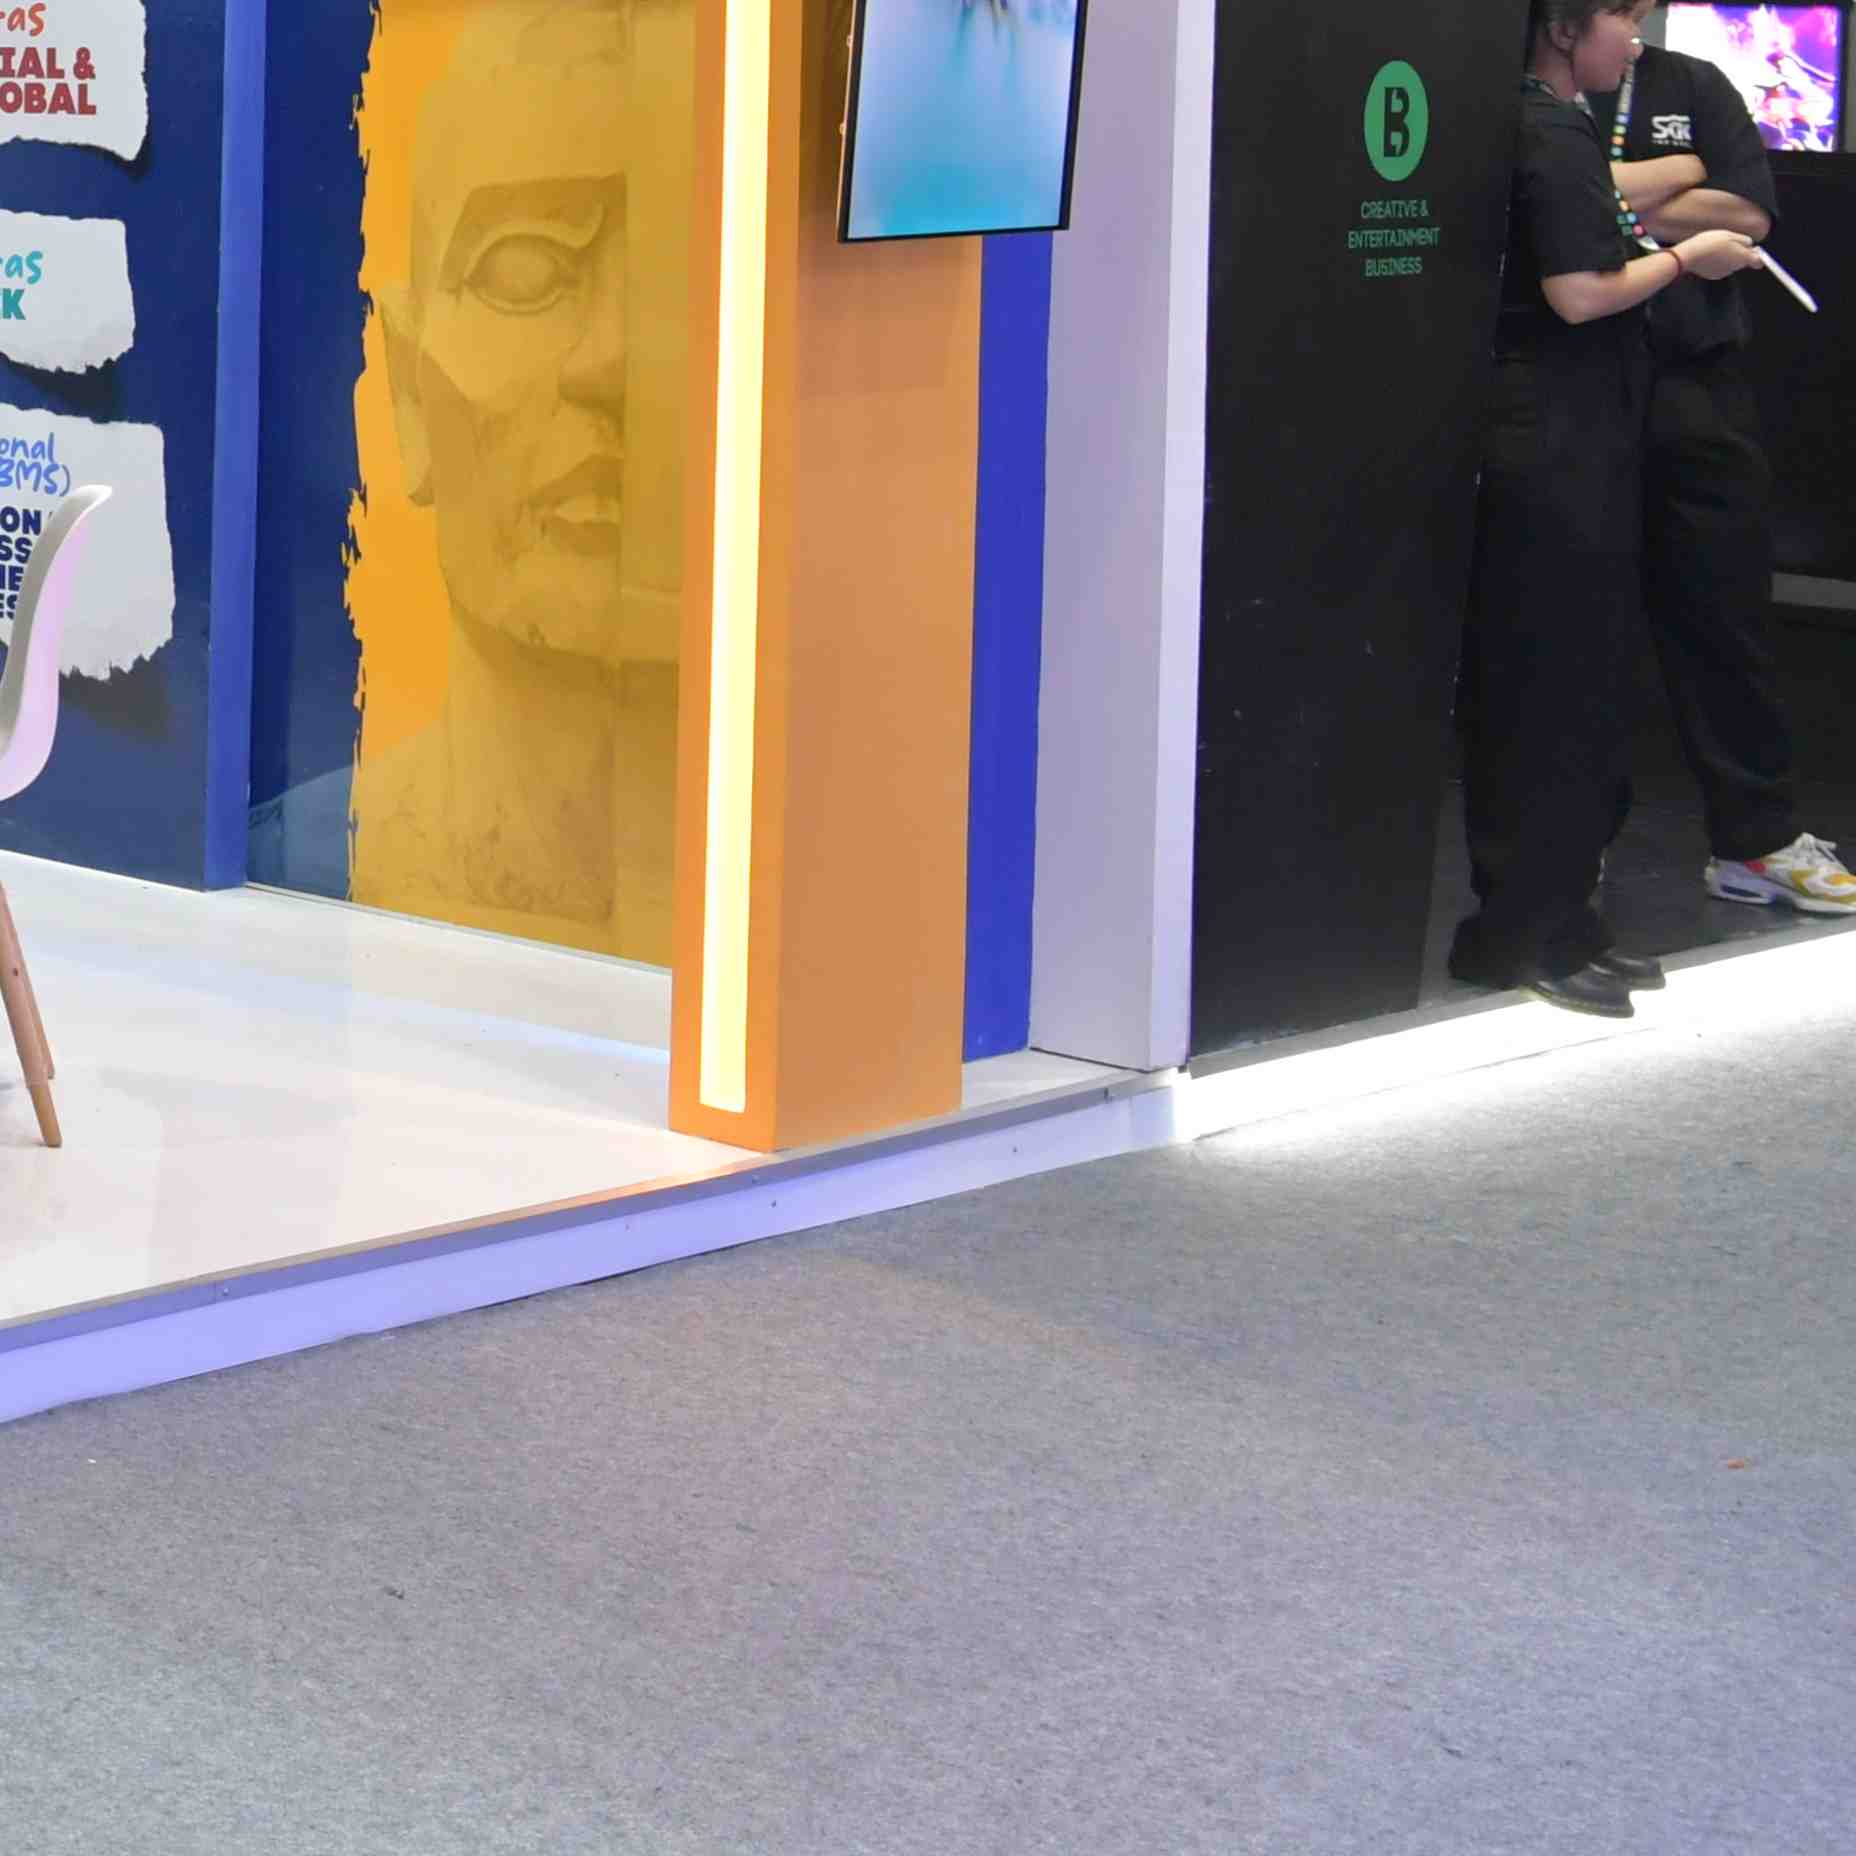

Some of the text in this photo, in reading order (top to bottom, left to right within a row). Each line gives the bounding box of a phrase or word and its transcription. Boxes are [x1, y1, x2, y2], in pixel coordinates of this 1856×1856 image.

[73, 46, 96, 80] &
[1360, 199, 1430, 218] CREATIVE &
[1348, 226, 1441, 249] ENTERTAINMENT
[1365, 256, 1423, 277] BUSINESS
